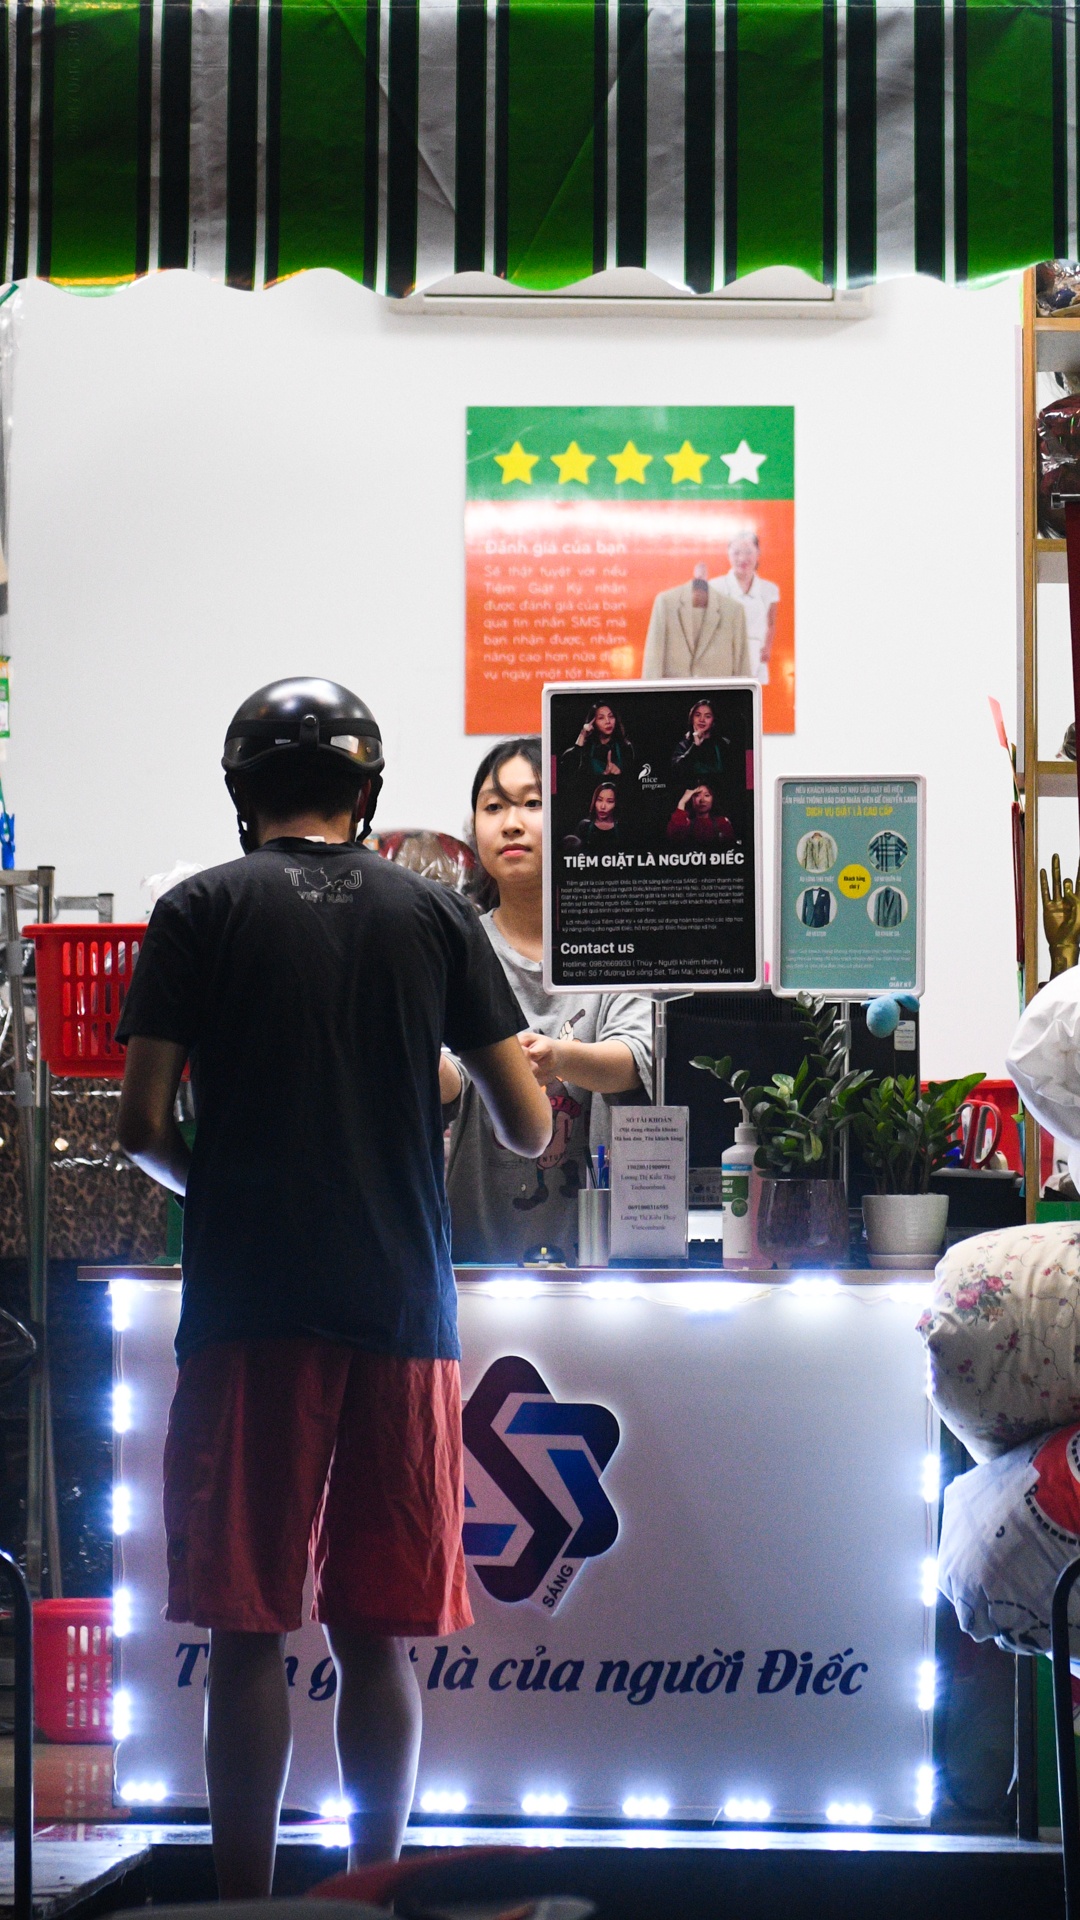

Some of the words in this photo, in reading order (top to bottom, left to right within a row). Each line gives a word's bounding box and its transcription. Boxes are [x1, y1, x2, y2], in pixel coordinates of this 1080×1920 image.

[485, 540, 528, 555] Đánh
[532, 540, 558, 558] giá
[562, 540, 592, 555] của
[596, 540, 626, 557] bạn
[564, 853, 598, 870] TIỆM
[601, 852, 635, 870] GIẶT
[637, 852, 656, 867] LÀ
[658, 852, 706, 866] NGƯỜI
[709, 848, 745, 865] ĐIẾC
[284, 868, 302, 886] T
[344, 870, 362, 890] J
[560, 942, 614, 954] Contact
[618, 944, 635, 954] us
[542, 1564, 575, 1609] SÁNG
[428, 1644, 480, 1692] là
[489, 1645, 586, 1692] của
[595, 1648, 746, 1706] người
[757, 1648, 869, 1696] Điếc
